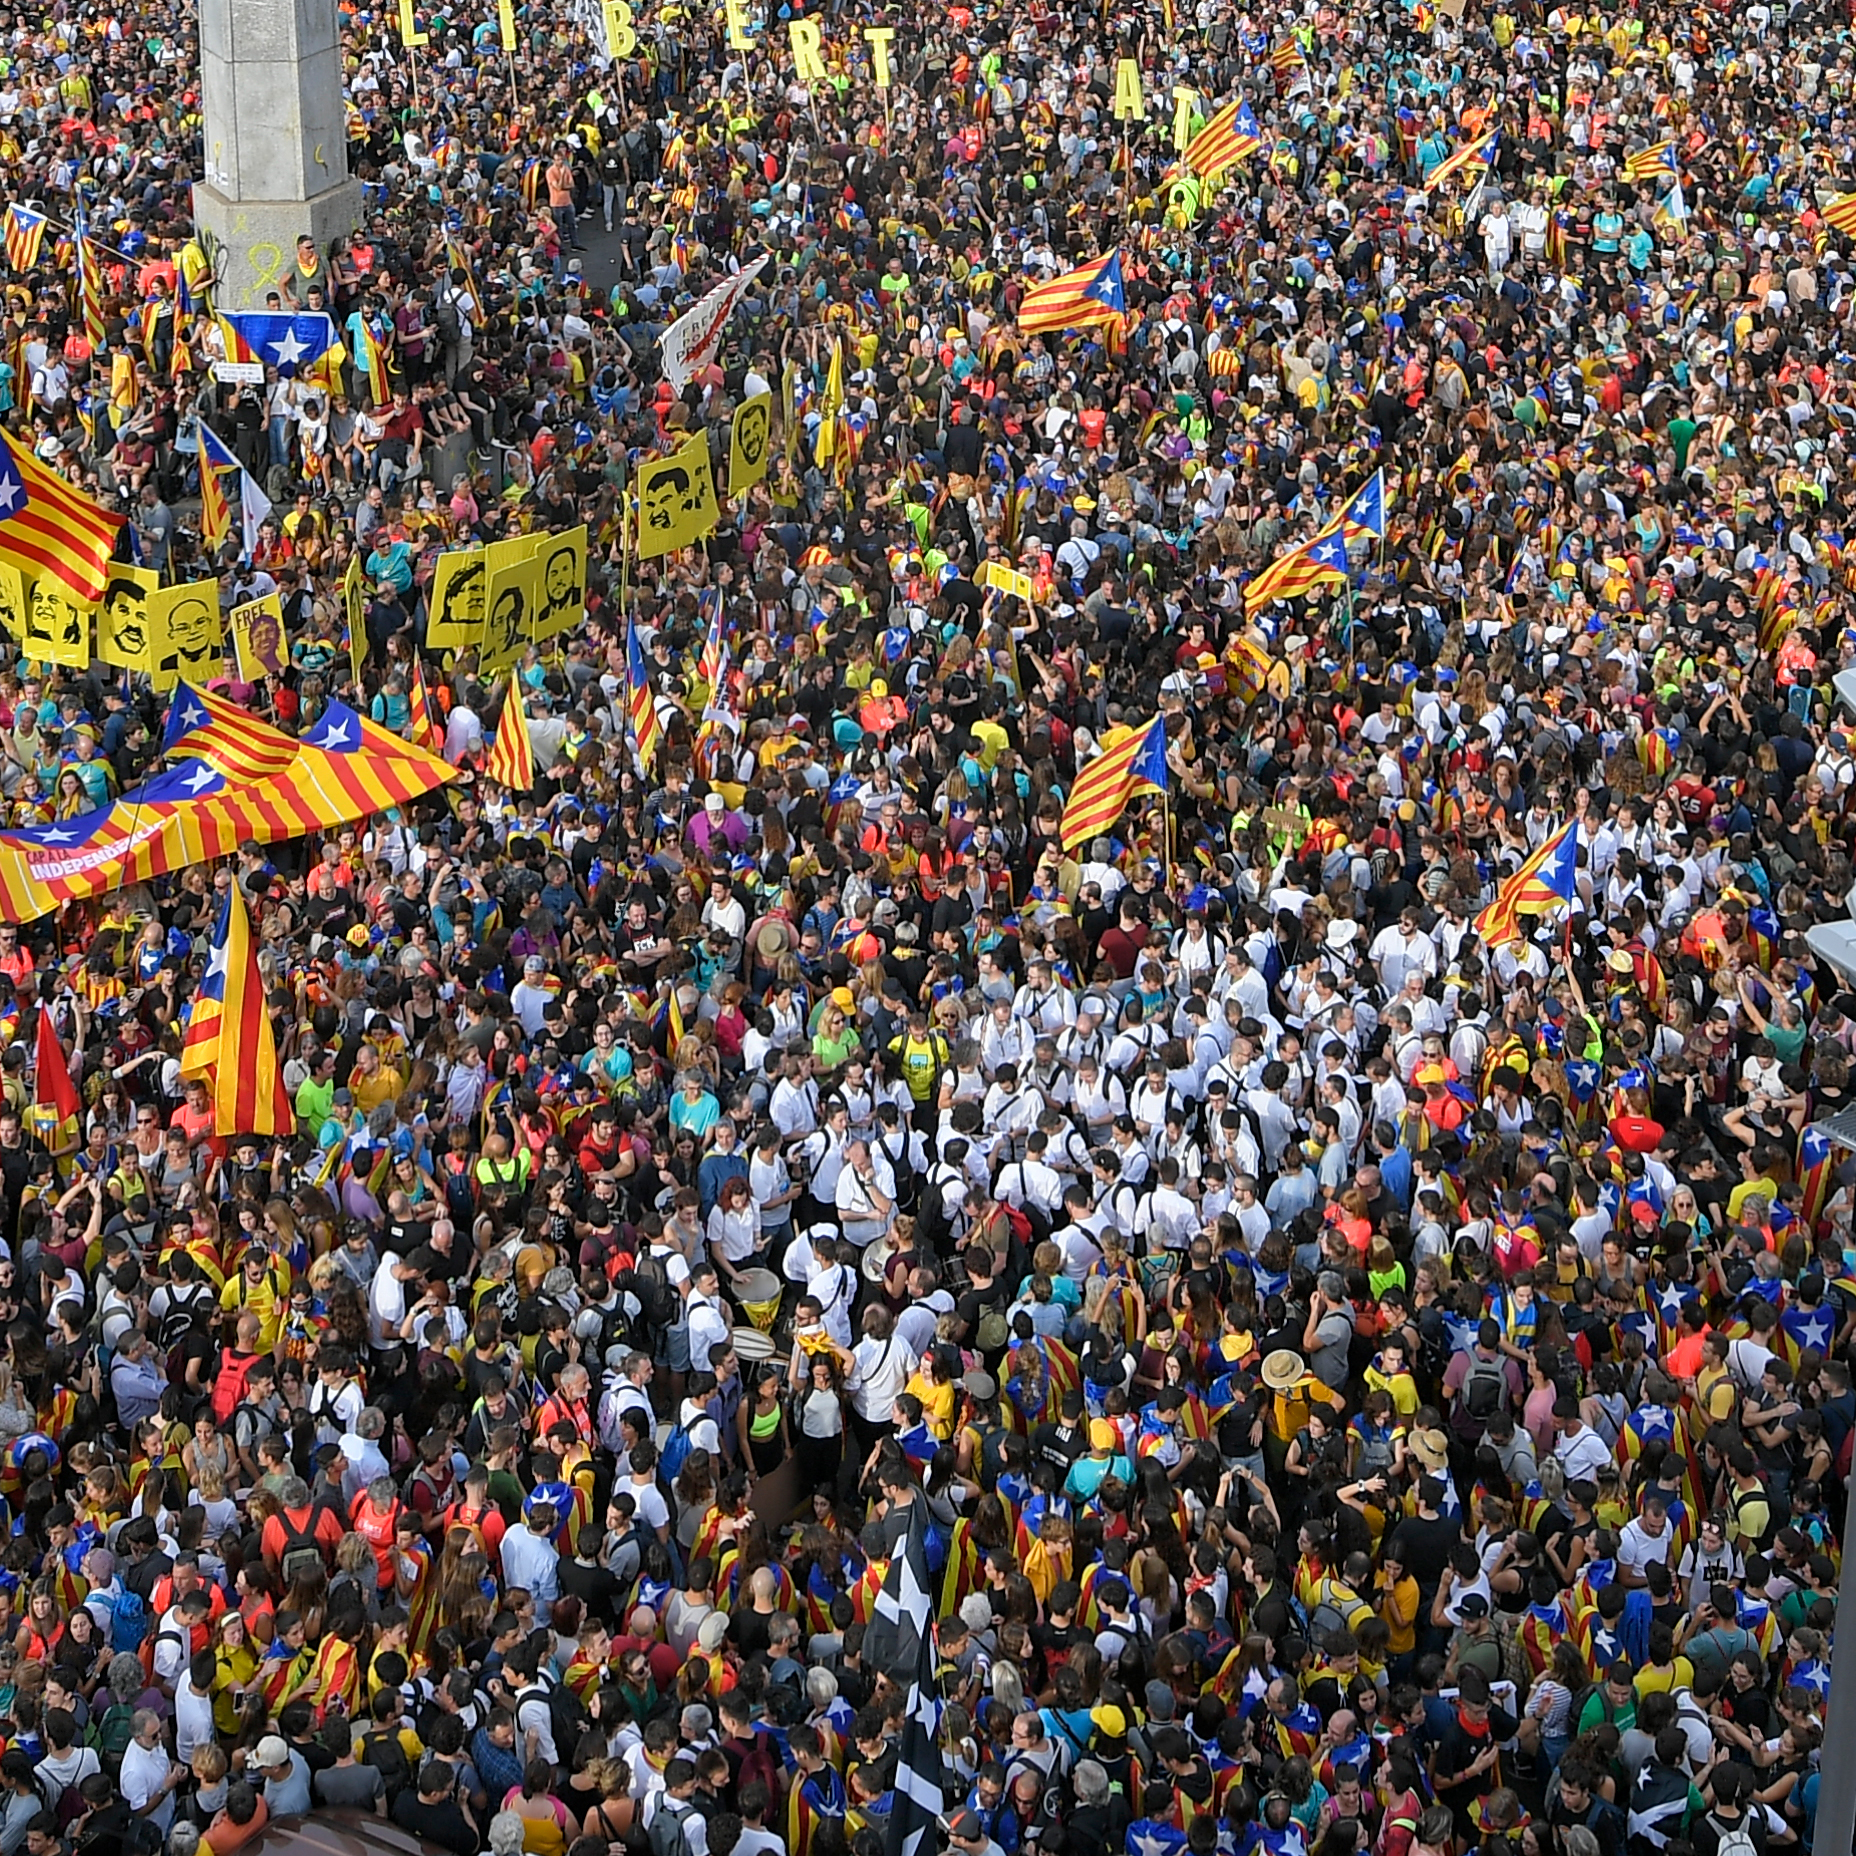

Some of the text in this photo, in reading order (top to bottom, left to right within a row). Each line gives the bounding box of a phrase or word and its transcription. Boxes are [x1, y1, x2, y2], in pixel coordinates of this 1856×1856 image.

[235, 602, 265, 630] FREE
[25, 849, 71, 864] CAP A LA
